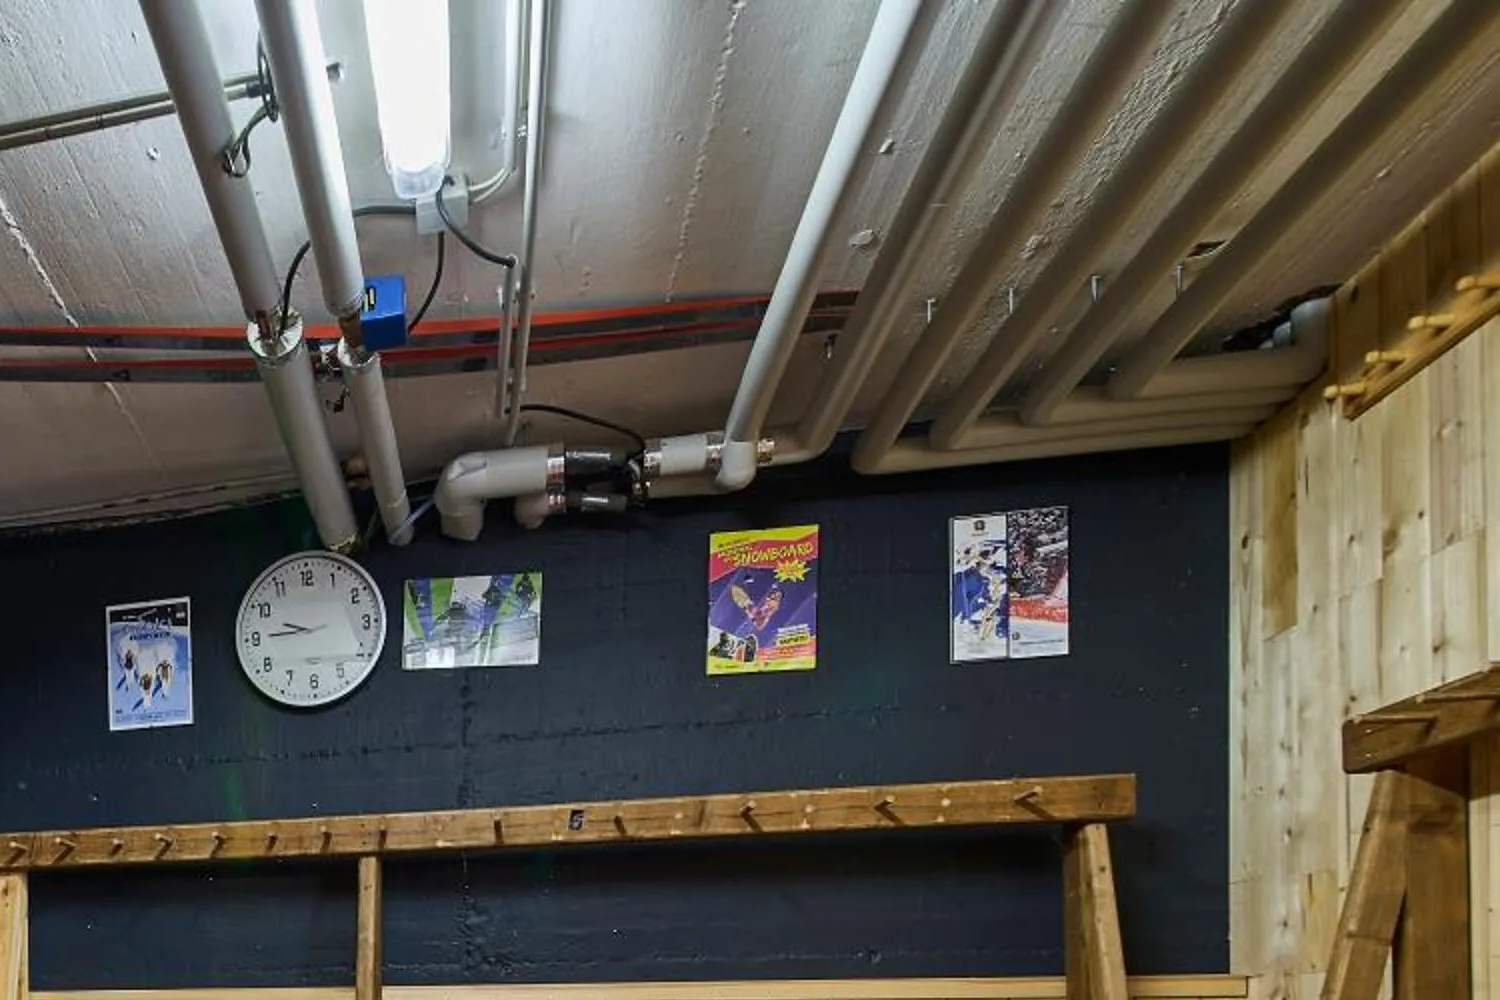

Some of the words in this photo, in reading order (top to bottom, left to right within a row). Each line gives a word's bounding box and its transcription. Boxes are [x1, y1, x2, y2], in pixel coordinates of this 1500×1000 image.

[733, 542, 813, 566] SNOWBOARD
[299, 569, 314, 587] 12
[329, 572, 337, 588] 1
[275, 581, 287, 598] 11
[350, 587, 361, 605] 2
[256, 601, 272, 619] 10
[361, 613, 371, 631] 3
[251, 631, 261, 647] 9
[263, 655, 273, 673] 8
[335, 661, 345, 679] 5
[285, 669, 294, 687] 7
[309, 673, 320, 690] 6
